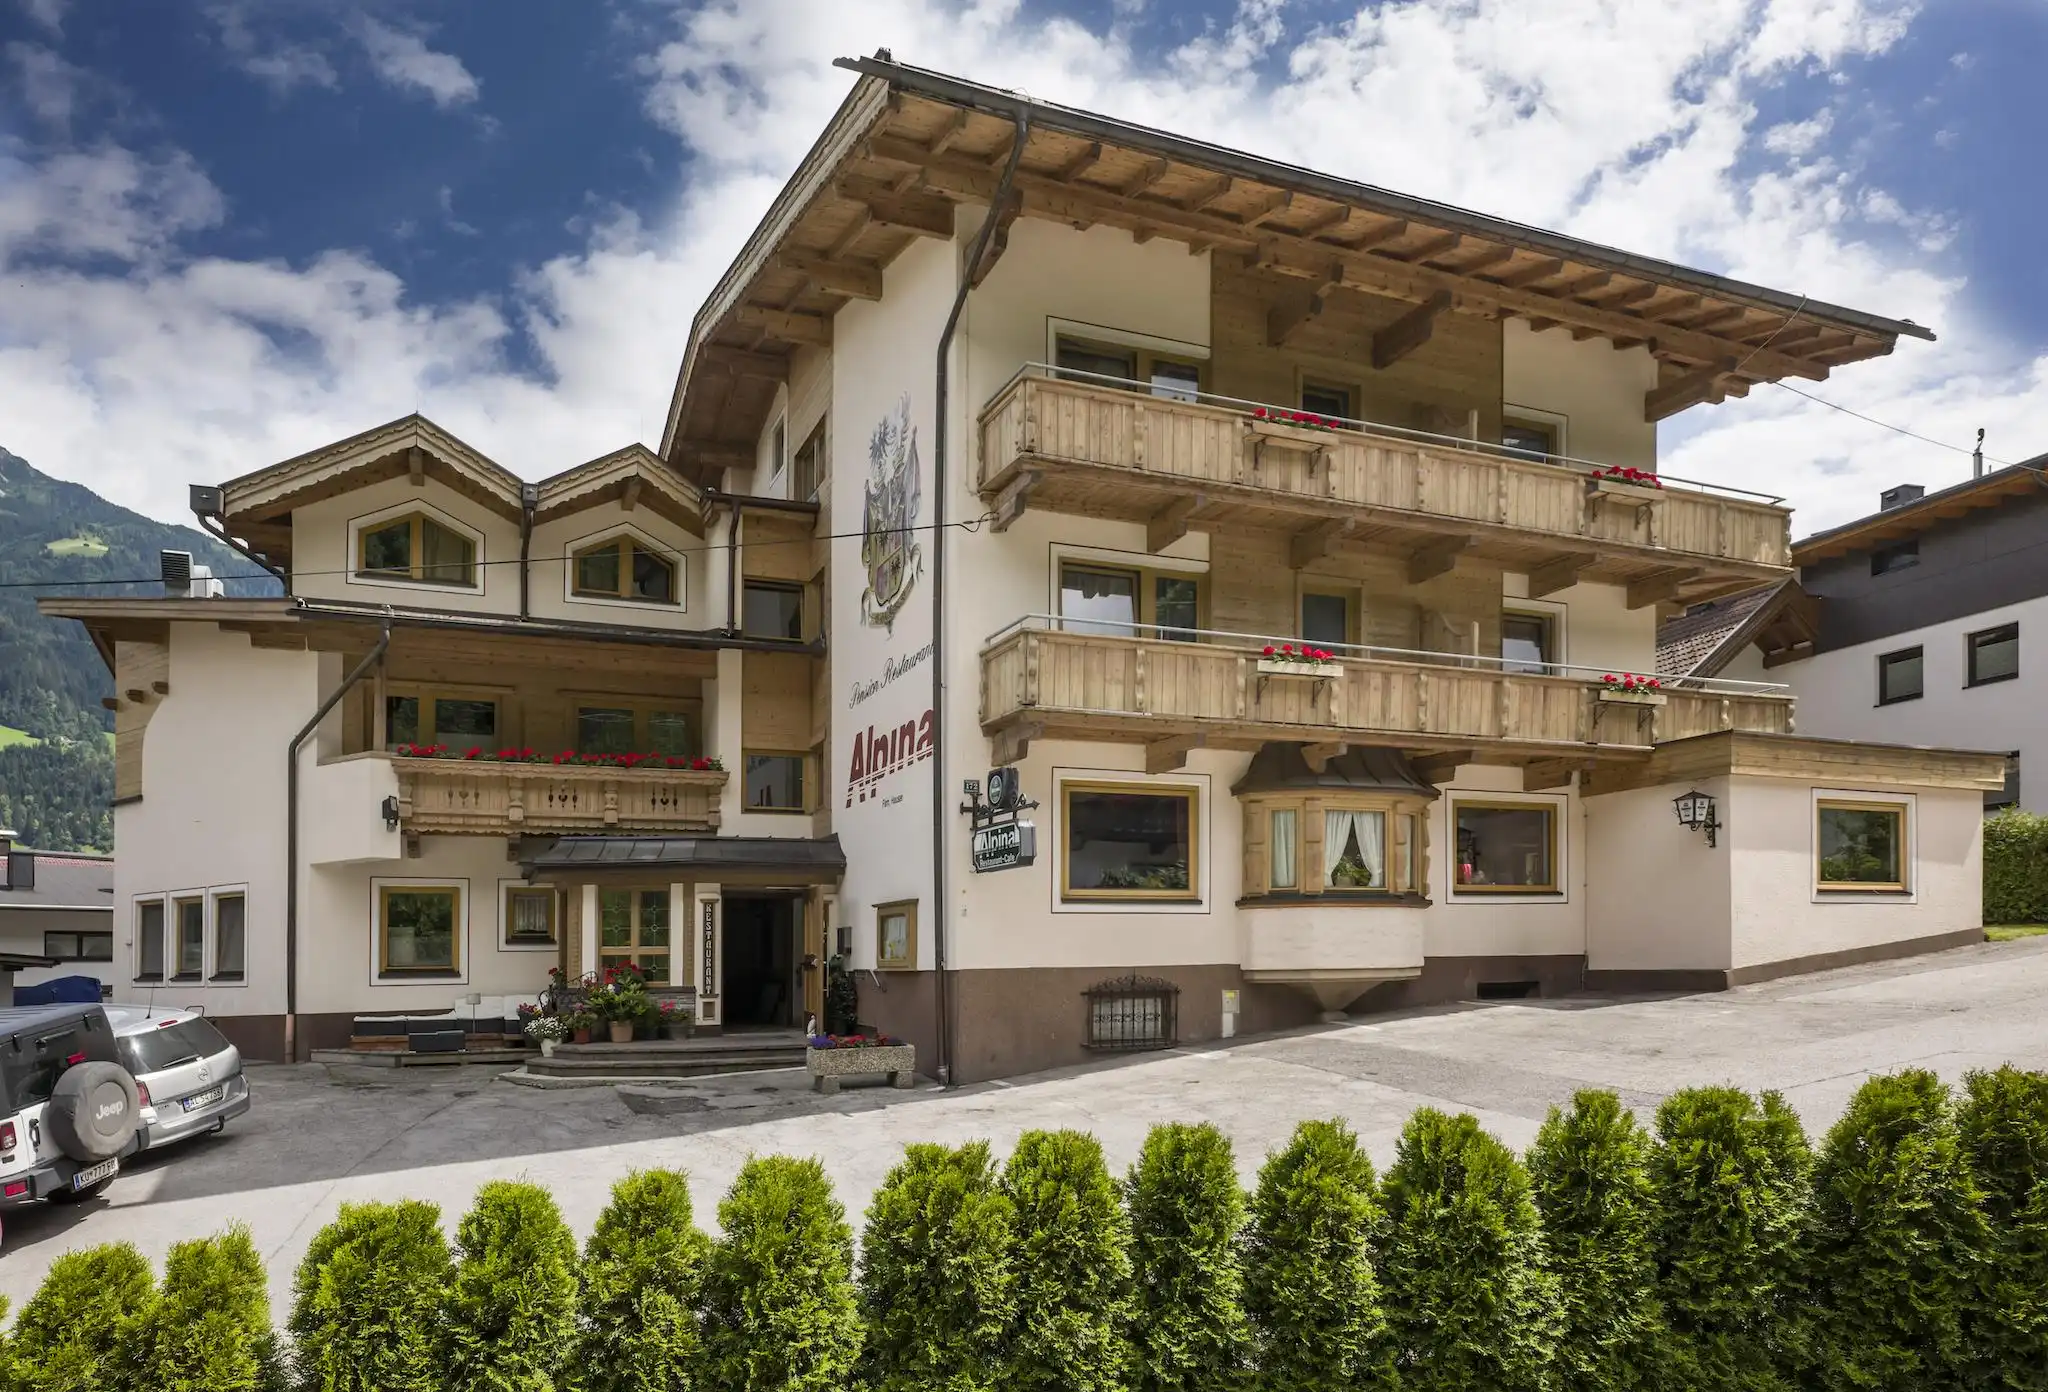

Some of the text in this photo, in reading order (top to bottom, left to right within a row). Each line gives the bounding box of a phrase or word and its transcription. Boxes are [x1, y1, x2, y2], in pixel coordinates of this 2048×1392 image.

[849, 681, 879, 709] Pension
[846, 709, 934, 808] Alpina
[980, 828, 1015, 857] Alpina
[705, 903, 713, 994] RESTAURANT
[95, 1100, 123, 1120] Jeep
